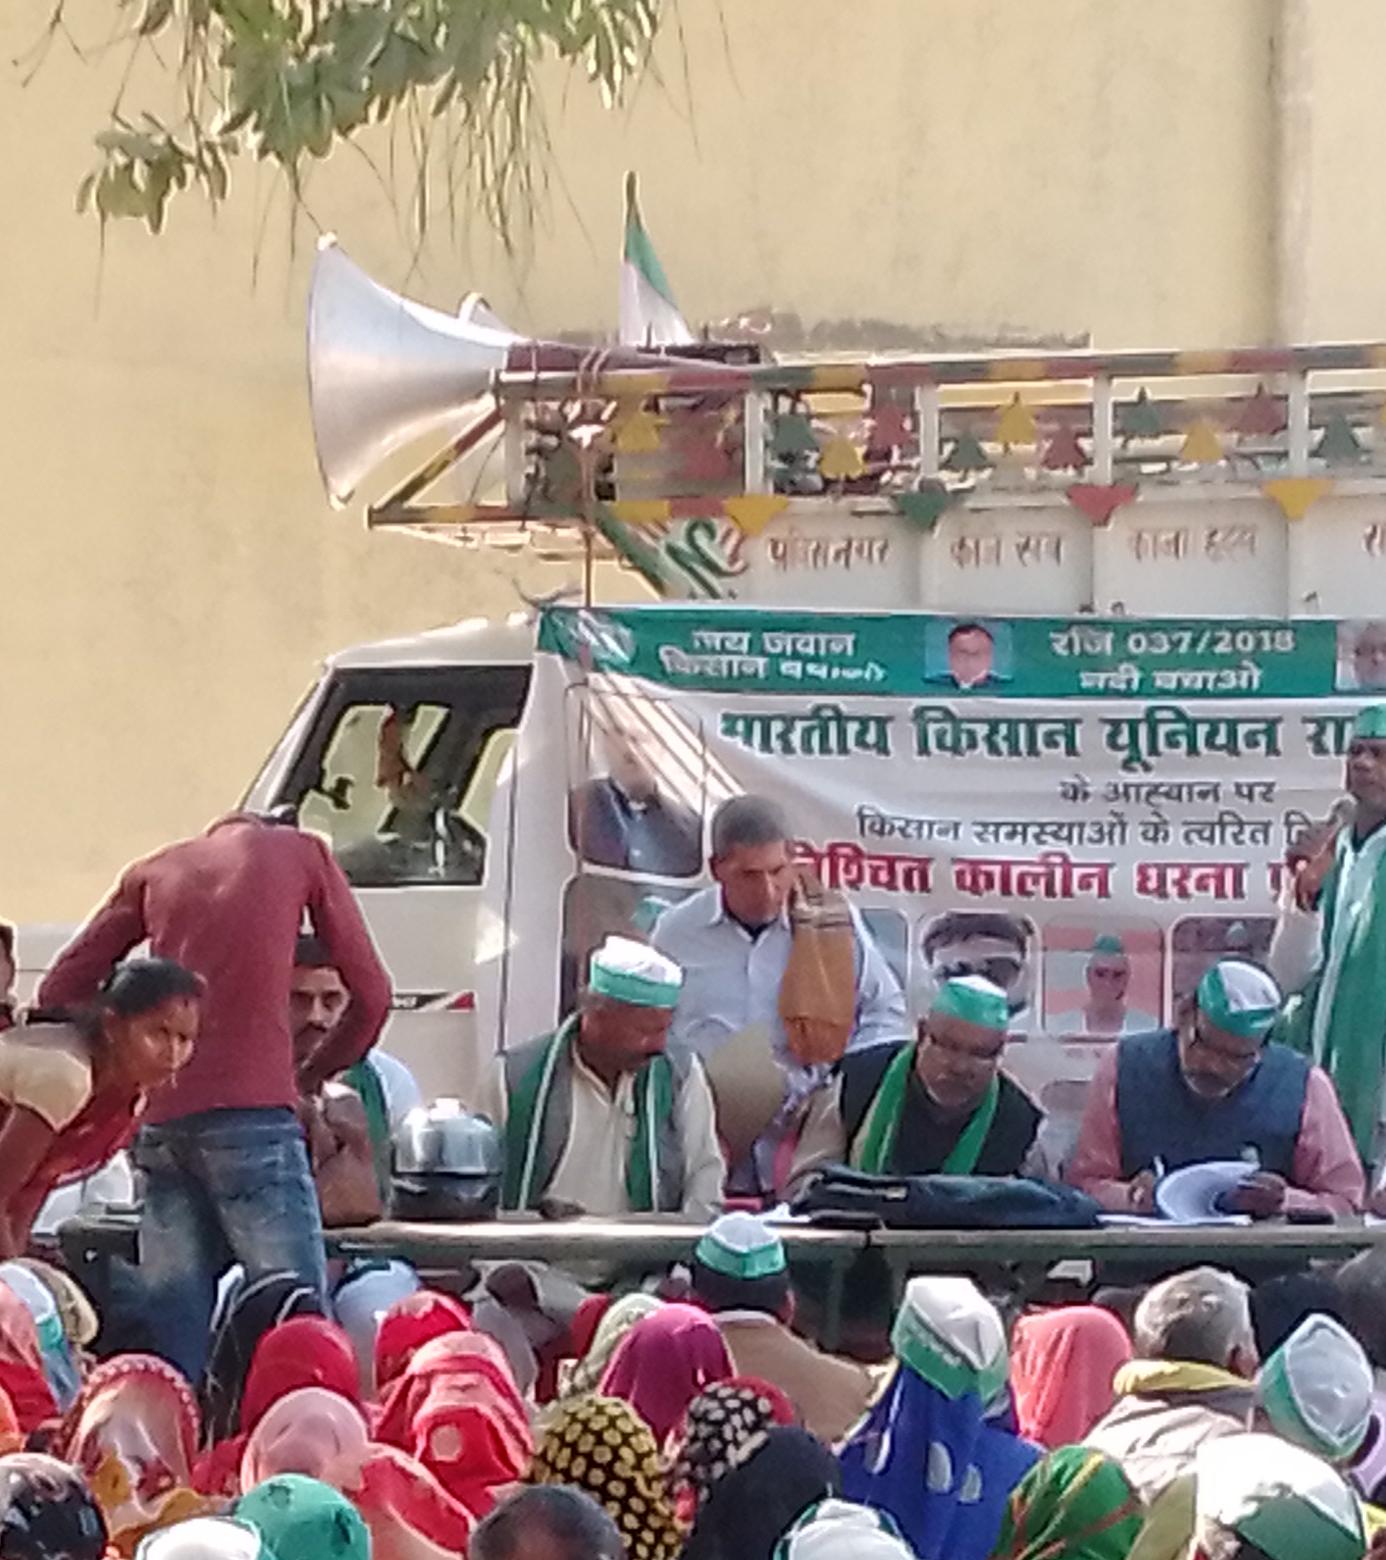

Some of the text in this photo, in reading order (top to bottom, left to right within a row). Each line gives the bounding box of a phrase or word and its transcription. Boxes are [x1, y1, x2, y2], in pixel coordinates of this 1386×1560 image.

[762, 631, 855, 657] जवान
[719, 703, 894, 757] भारतीय
[913, 705, 1083, 758] किसान
[1099, 705, 1284, 773] यूनियन
[1059, 773, 1091, 803] के
[1233, 781, 1277, 803] पर
[857, 805, 963, 841] किसान
[971, 810, 1128, 846] समस्याओं
[1138, 811, 1170, 845] के
[1181, 810, 1273, 846] त्वरित
[950, 852, 1116, 899] कालीन
[1135, 861, 1250, 900] धरना
